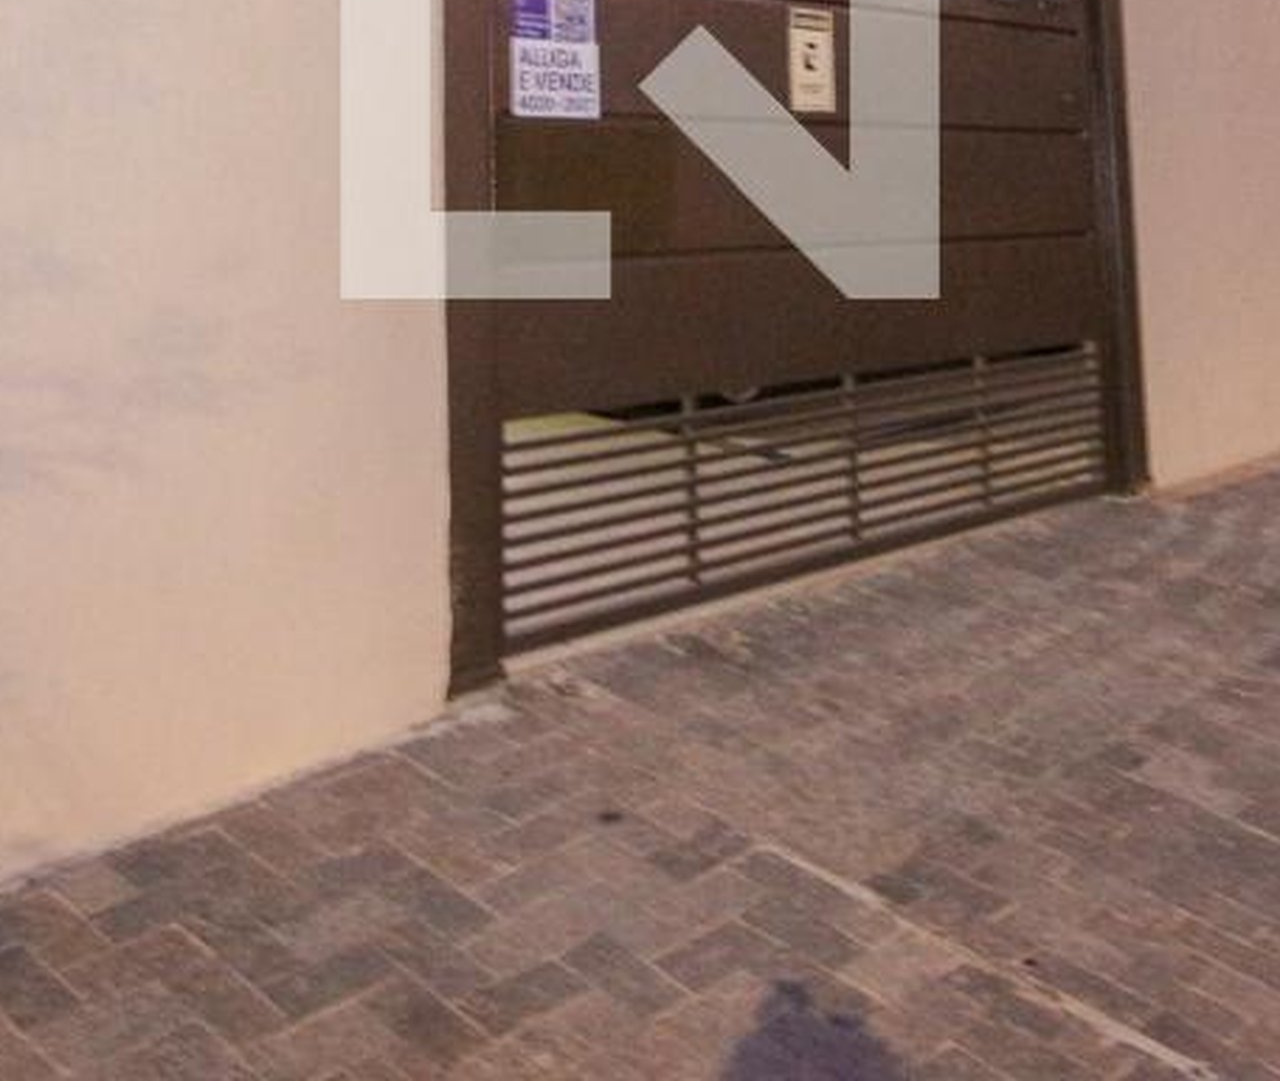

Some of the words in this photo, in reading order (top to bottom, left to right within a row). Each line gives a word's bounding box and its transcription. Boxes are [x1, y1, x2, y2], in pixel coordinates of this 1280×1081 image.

[520, 47, 583, 69] ALUGA
[520, 70, 530, 91] E
[535, 71, 595, 93] VENDE
